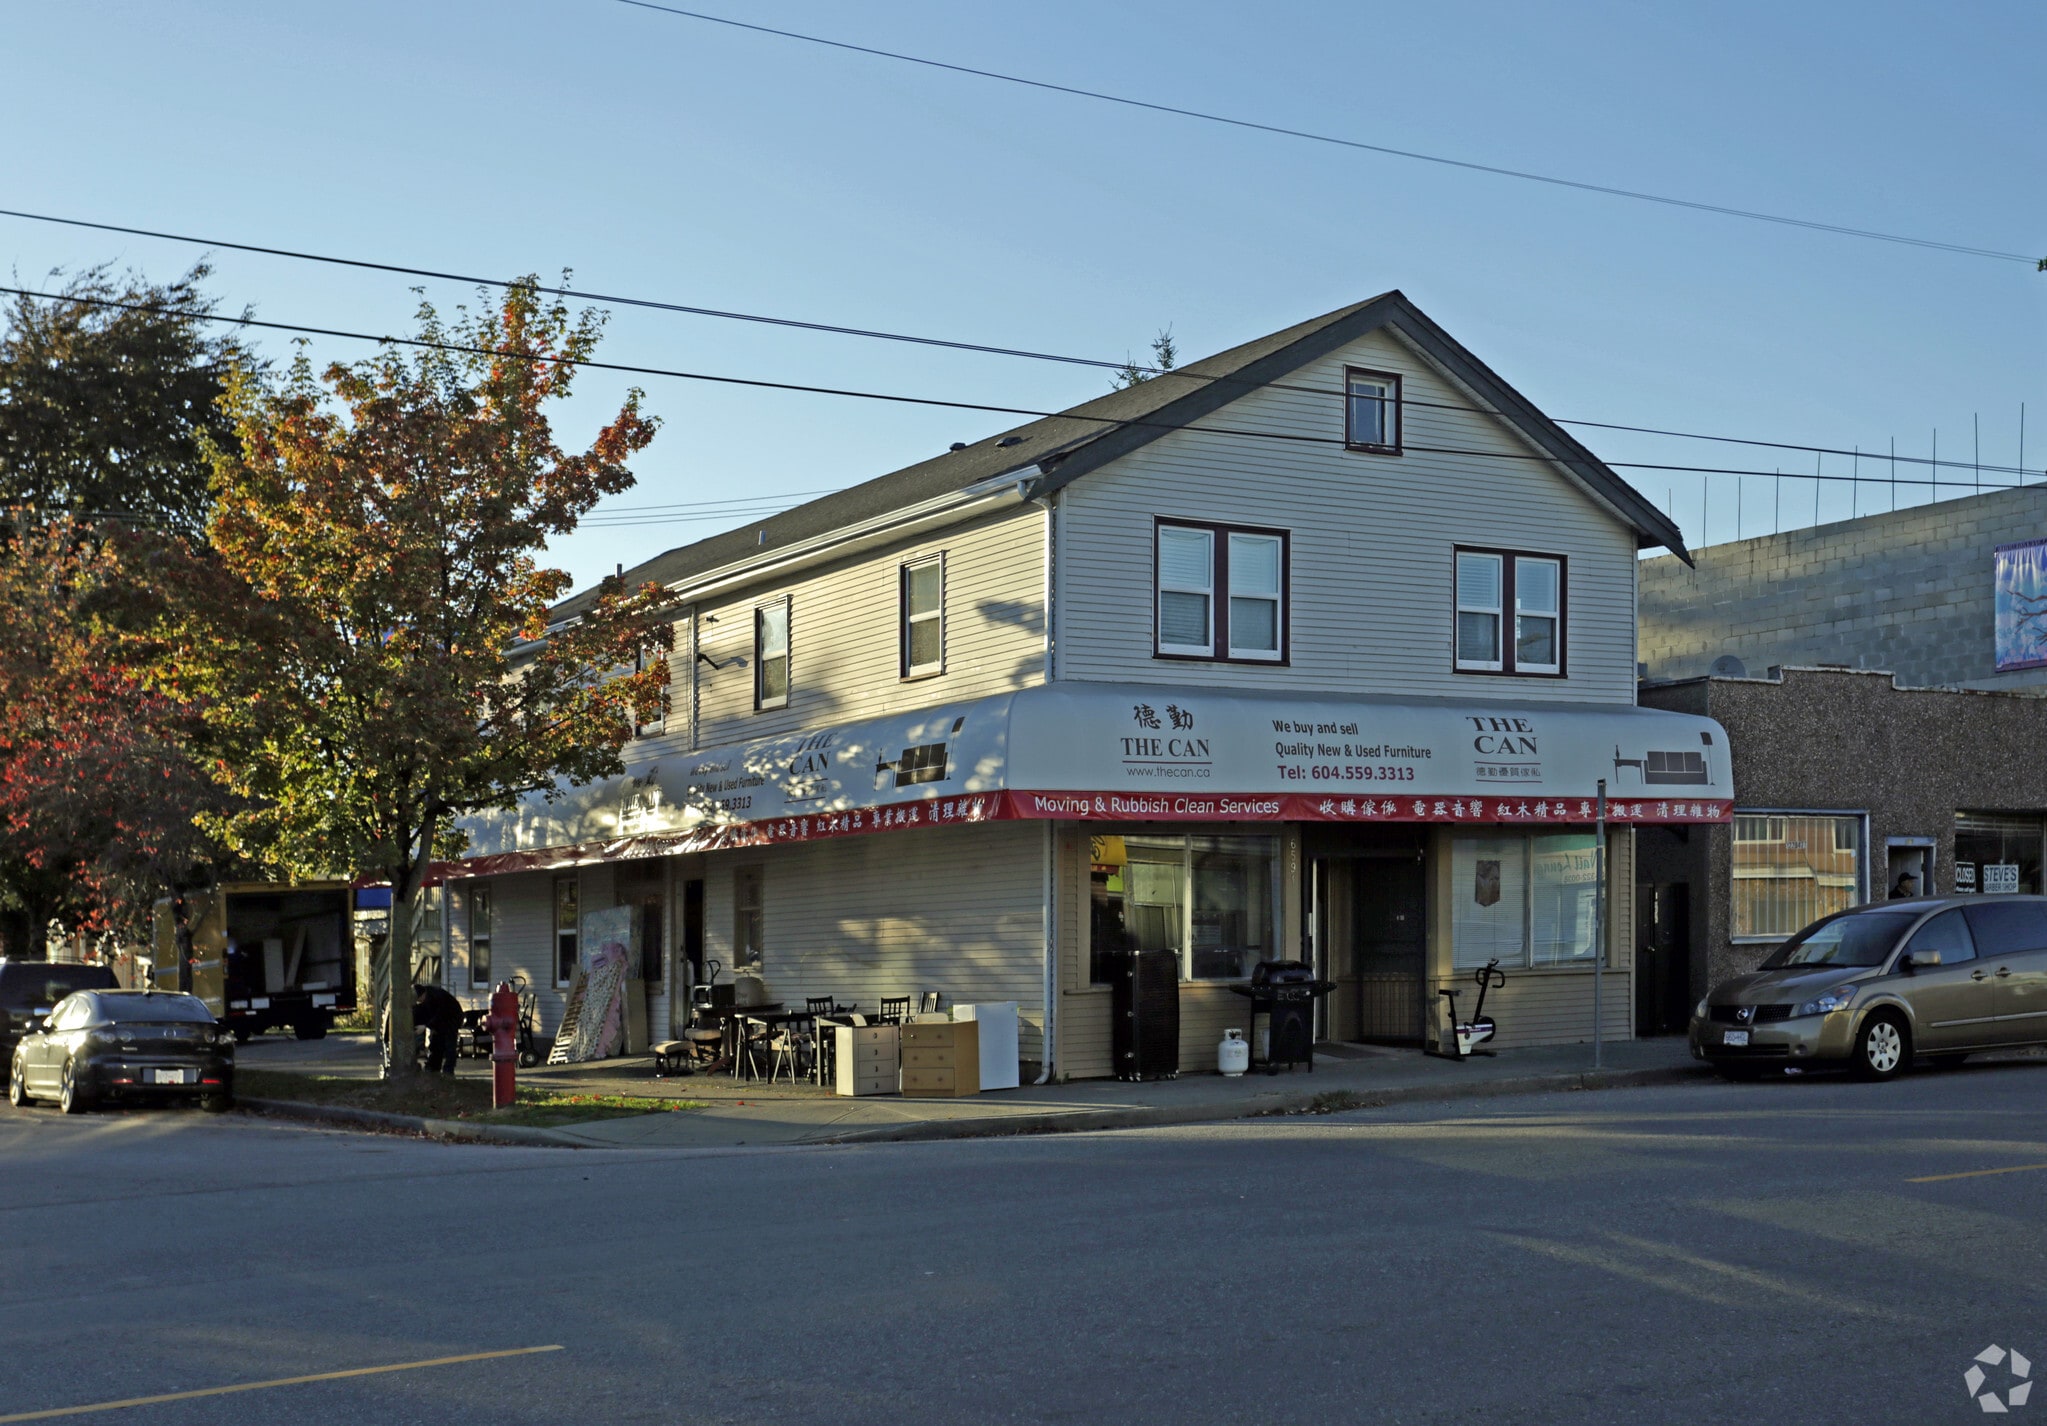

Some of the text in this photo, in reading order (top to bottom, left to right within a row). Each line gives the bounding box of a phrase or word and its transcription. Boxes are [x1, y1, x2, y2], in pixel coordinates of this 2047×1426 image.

[1133, 703, 1194, 731] 德勤
[1465, 716, 1534, 733] THE
[1272, 719, 1358, 737] We buy and sell
[1120, 737, 1210, 758] THE CAN
[1275, 741, 1432, 759] Quality New & Used Furniture
[1473, 735, 1538, 755] CAN
[789, 751, 831, 775] CAN
[1126, 765, 1210, 778] www.thecan.ca
[1277, 765, 1415, 781] Tel: 604.559.3313
[1034, 796, 1279, 816] Moving & Rubbish Clean Services
[1412, 799, 1483, 818] 電器音響
[1497, 801, 1567, 819] 紅木精品
[1578, 802, 1644, 819] 專搬運
[1984, 867, 2017, 882] STEVE'S
